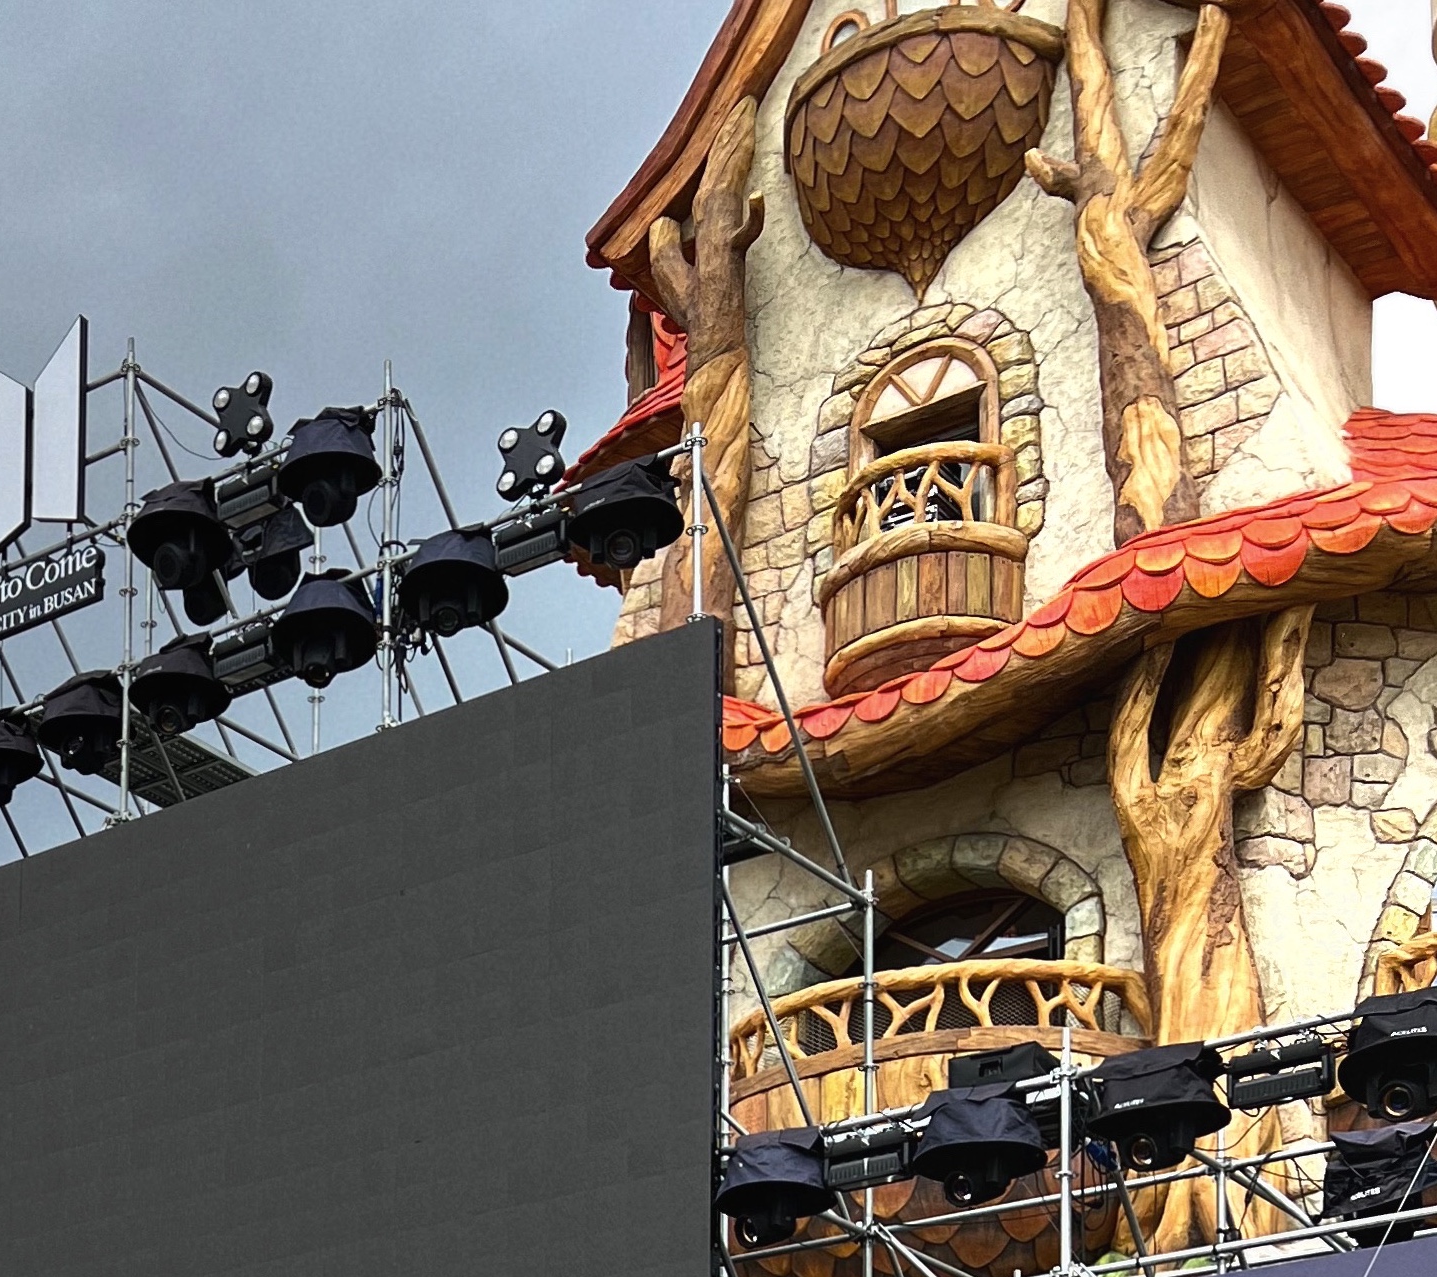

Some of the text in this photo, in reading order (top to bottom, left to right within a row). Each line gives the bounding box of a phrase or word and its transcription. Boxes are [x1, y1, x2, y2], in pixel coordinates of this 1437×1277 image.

[0, 576, 23, 603] to
[25, 546, 98, 590] Come
[28, 603, 43, 620] in
[43, 578, 97, 615] BUSAN
